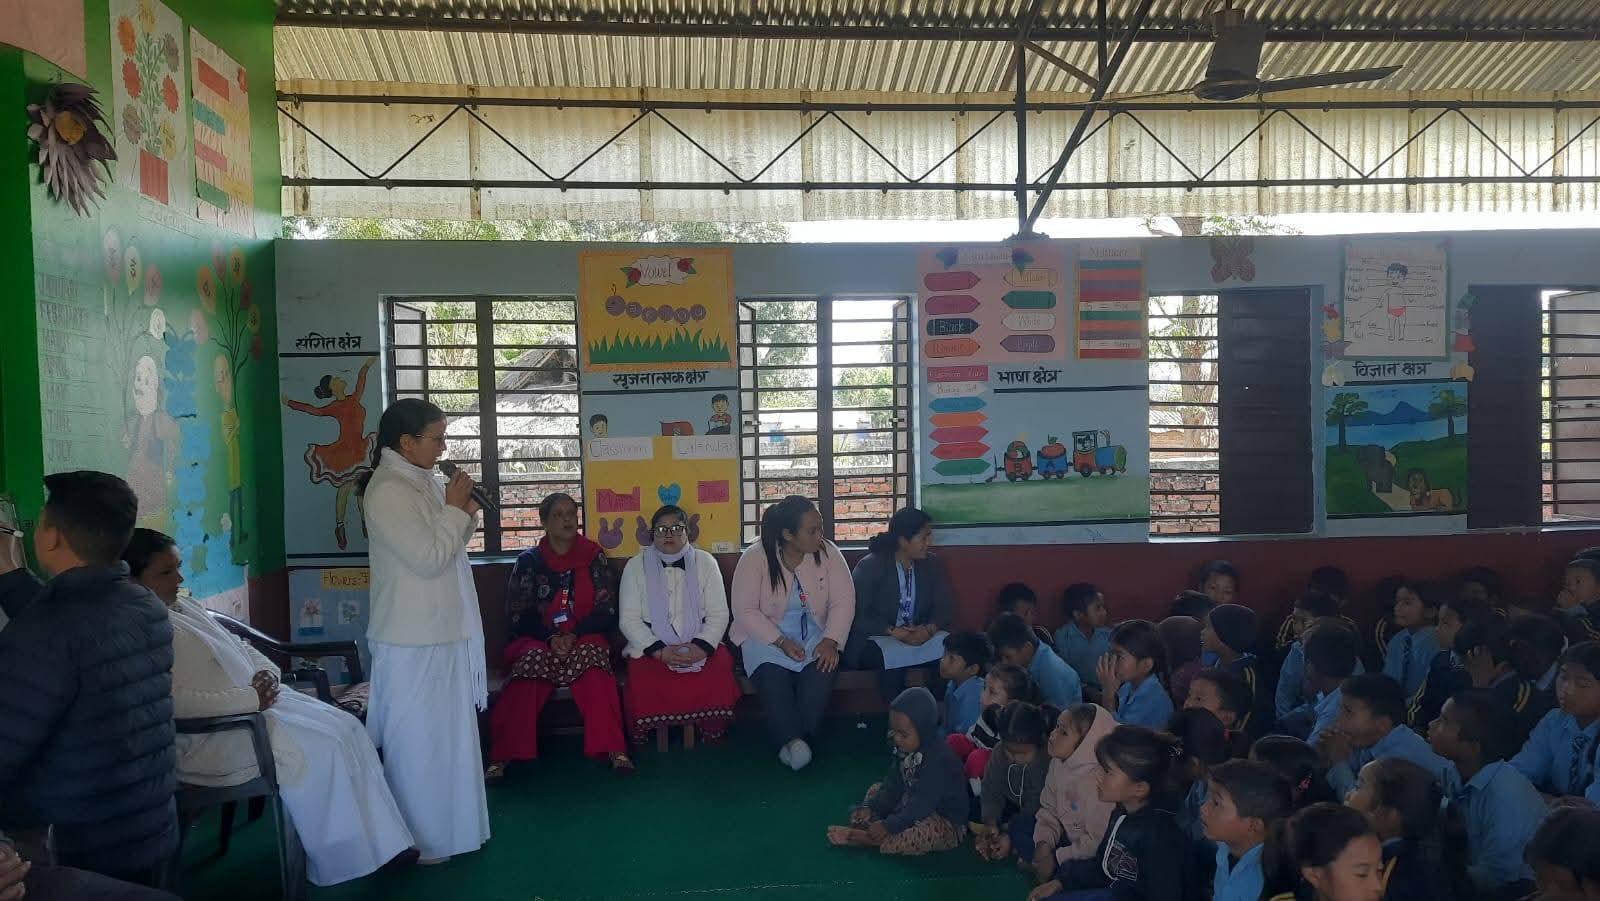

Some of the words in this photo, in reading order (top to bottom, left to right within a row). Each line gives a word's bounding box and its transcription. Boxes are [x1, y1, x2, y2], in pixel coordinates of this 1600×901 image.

[640, 262, 672, 279] Vowel
[938, 320, 962, 334] Black
[338, 331, 361, 350] क्षेत्र
[997, 370, 1030, 384] भाषा
[1032, 365, 1063, 384] क्षेत्र
[1352, 360, 1400, 378] विज्ञान
